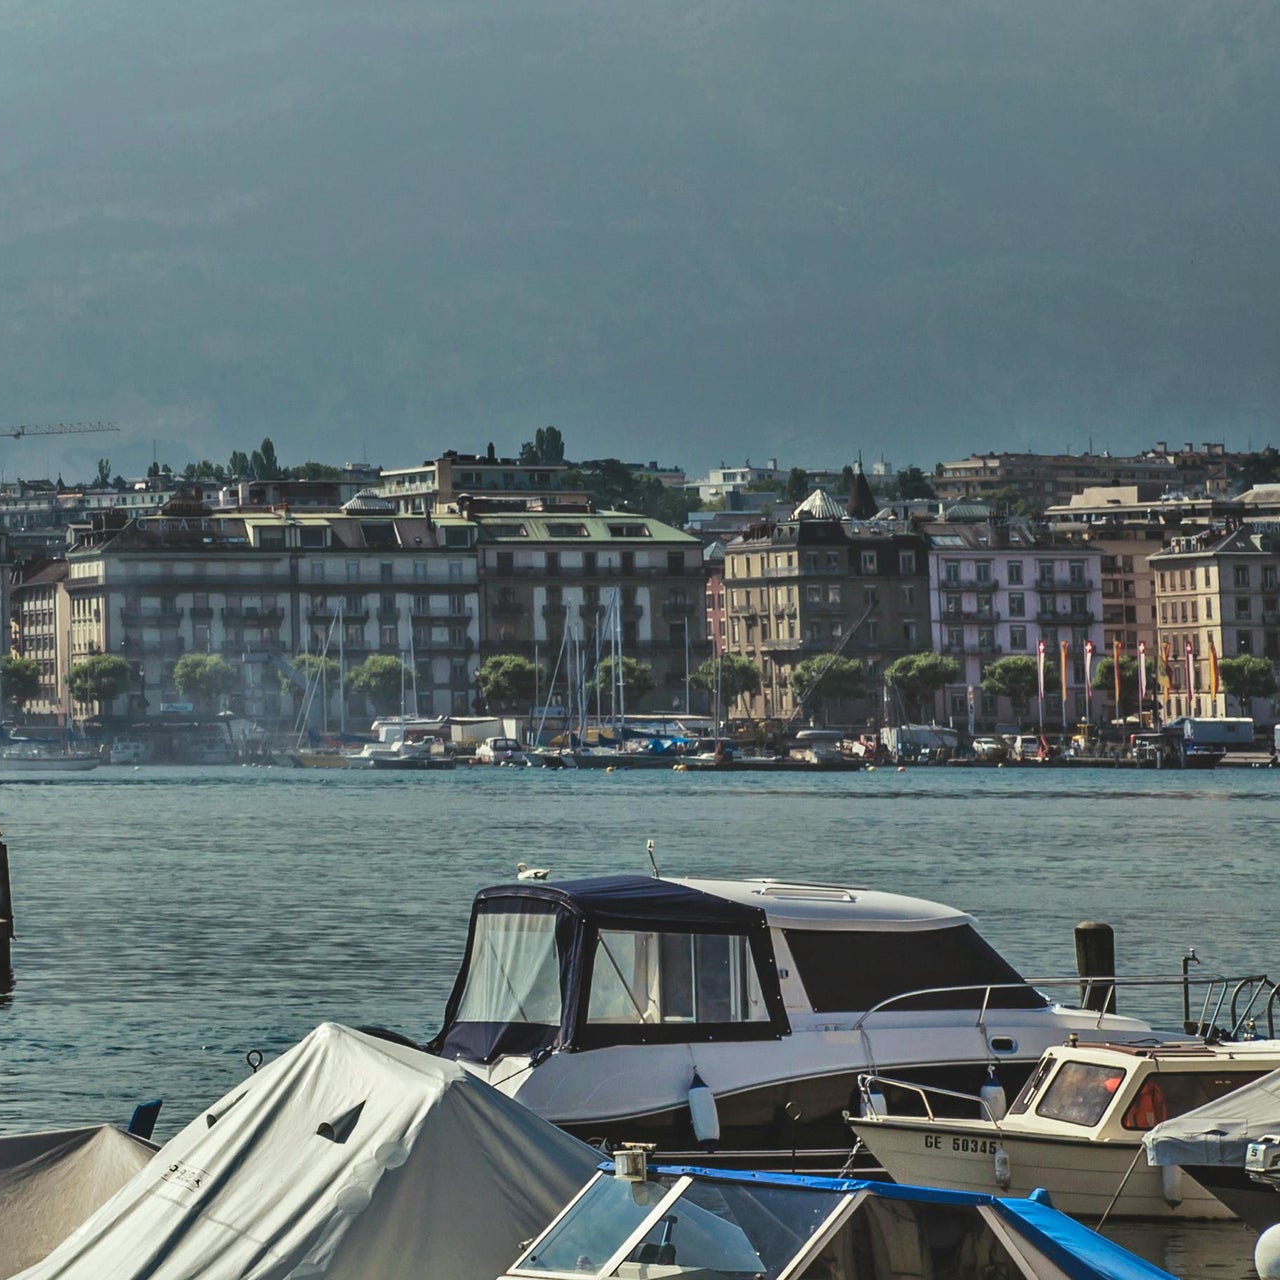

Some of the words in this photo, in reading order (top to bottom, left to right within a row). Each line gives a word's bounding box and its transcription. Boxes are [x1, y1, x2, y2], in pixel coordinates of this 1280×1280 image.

[136, 519, 228, 531] GRAFF
[924, 1134, 941, 1149] GE
[952, 1138, 997, 1154] 50345
